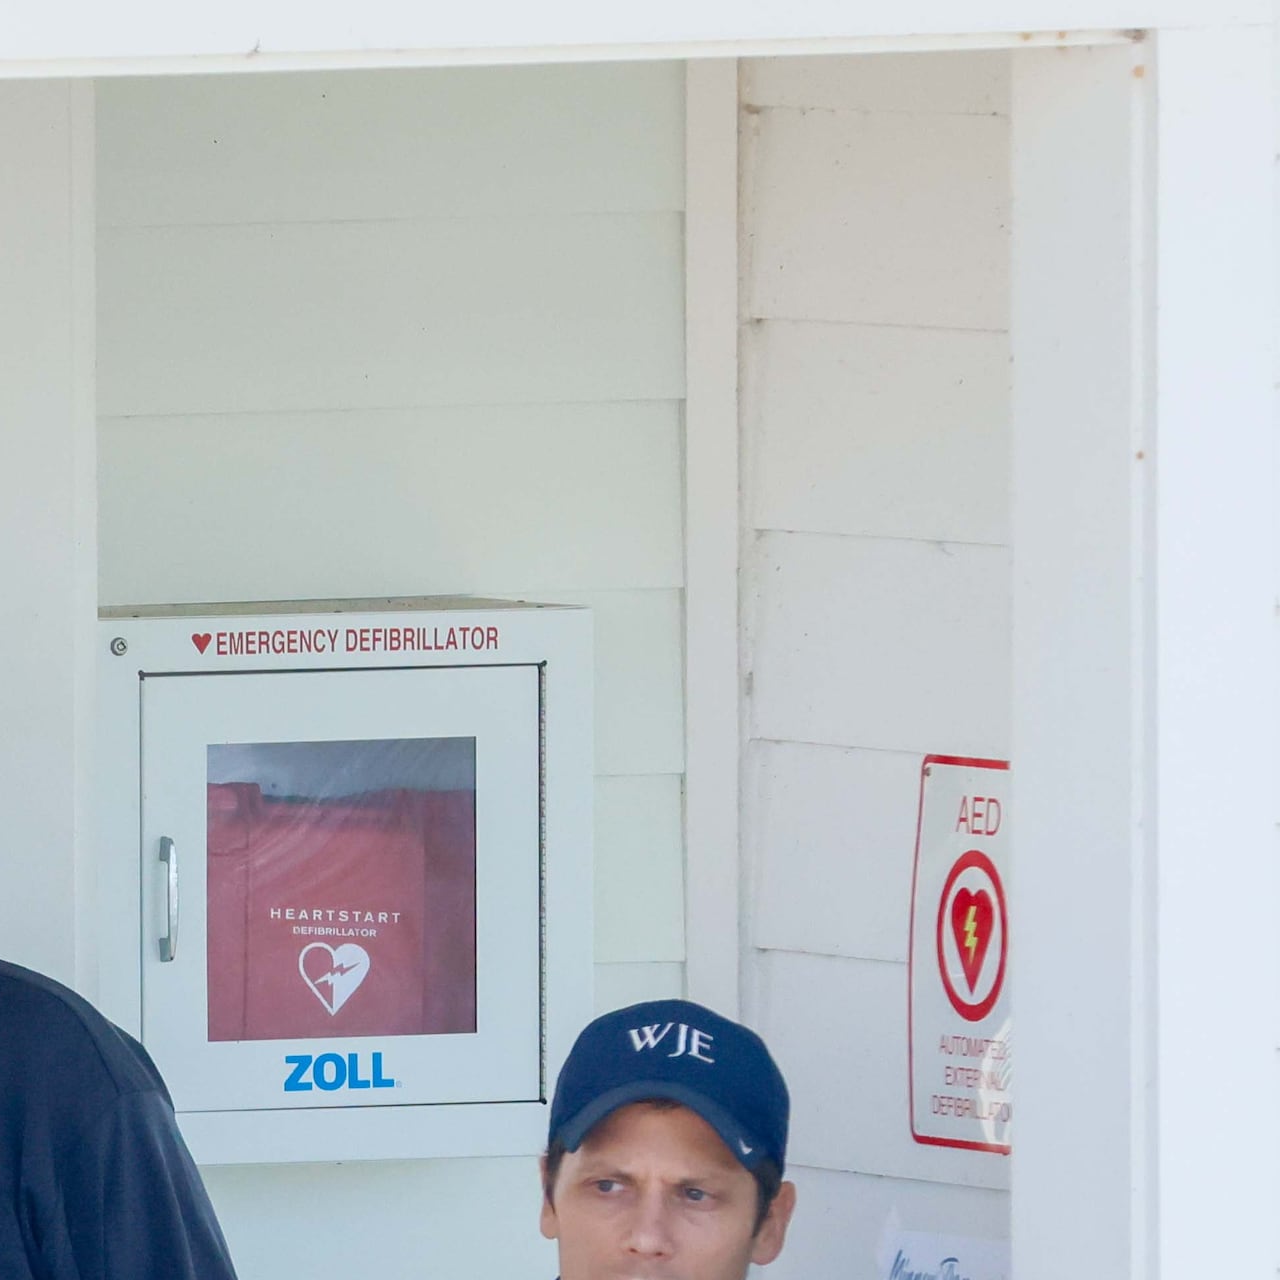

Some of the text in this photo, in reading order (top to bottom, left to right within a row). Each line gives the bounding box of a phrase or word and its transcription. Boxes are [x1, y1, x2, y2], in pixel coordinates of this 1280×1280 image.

[216, 627, 498, 655] EMERGENCY DEFIBRILLATOR
[955, 795, 1001, 836] AED
[270, 908, 400, 923] HEARTSTART
[293, 926, 376, 937] DEFIBRILLATOR
[628, 1022, 715, 1064] WJE
[284, 1052, 394, 1091] ZOLL
